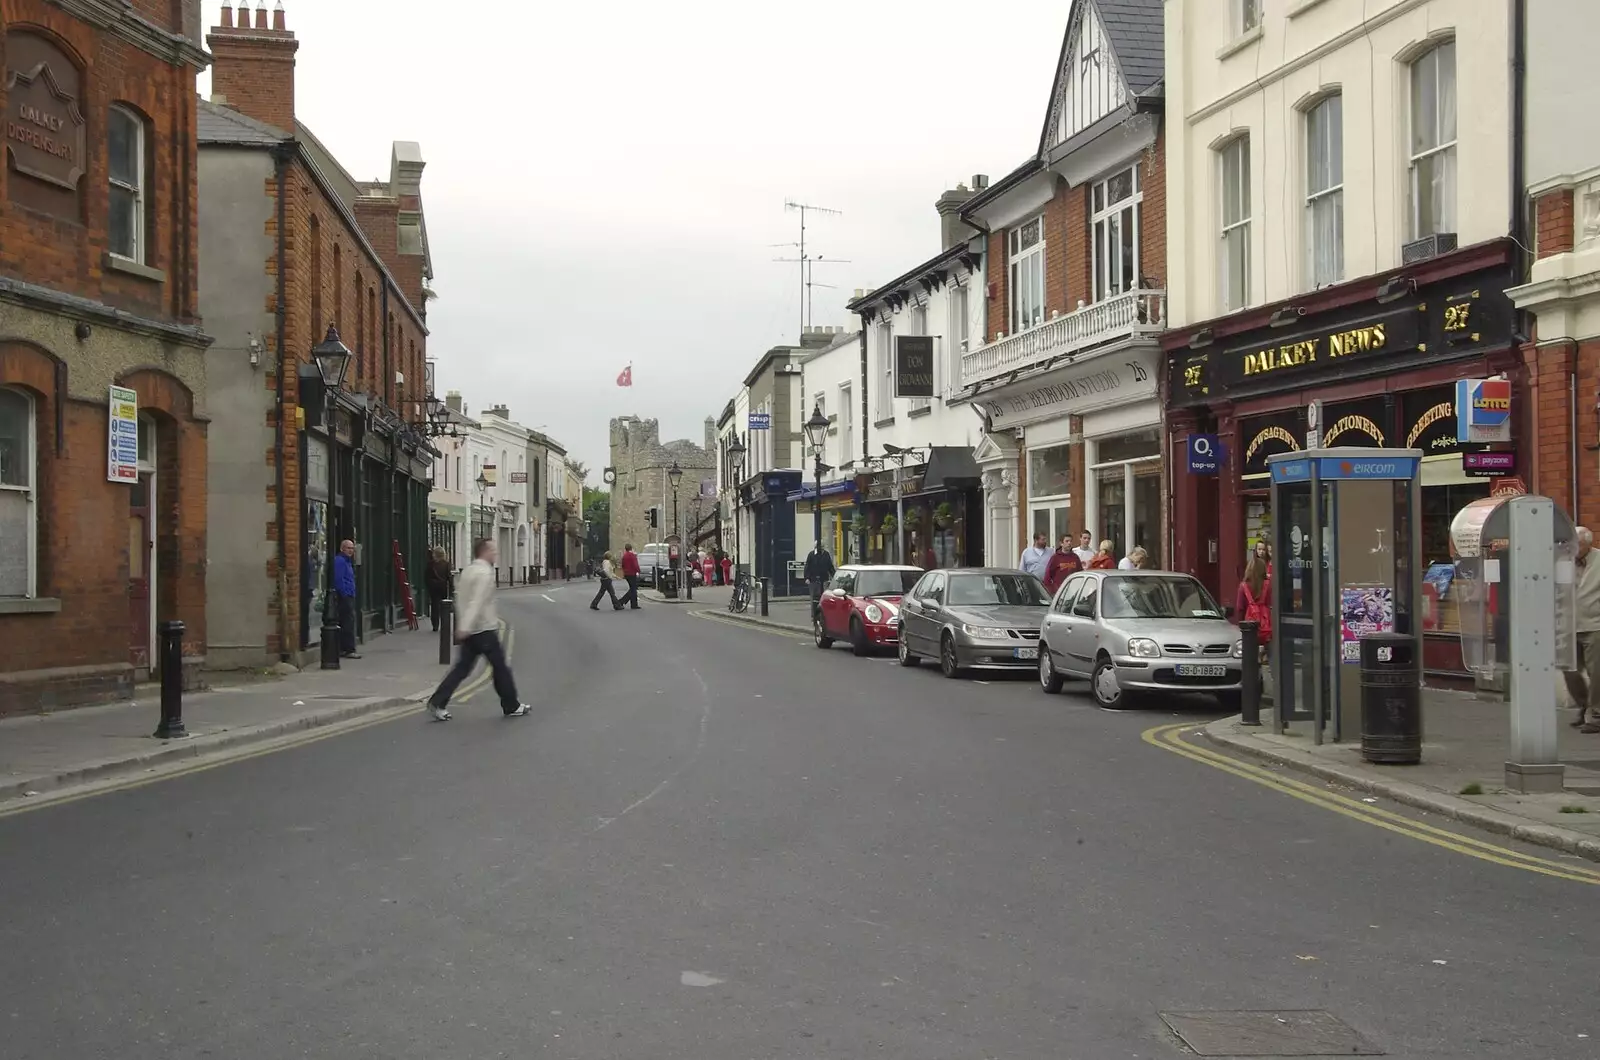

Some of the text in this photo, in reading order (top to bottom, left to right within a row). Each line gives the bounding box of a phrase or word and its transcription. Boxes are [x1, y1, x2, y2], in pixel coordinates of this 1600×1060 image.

[20, 103, 64, 132] DALKEY
[8, 122, 72, 161] DISPENSARY
[1443, 303, 1471, 332] 27
[1243, 323, 1386, 376] DALKEY NEWS
[986, 360, 1149, 418] 26 THE BEDROOM STUDIO 26
[1184, 365, 1202, 386] 27
[1322, 414, 1386, 449] STATIONERY
[1406, 402, 1453, 450] GREETING
[1481, 456, 1509, 465] payzone
